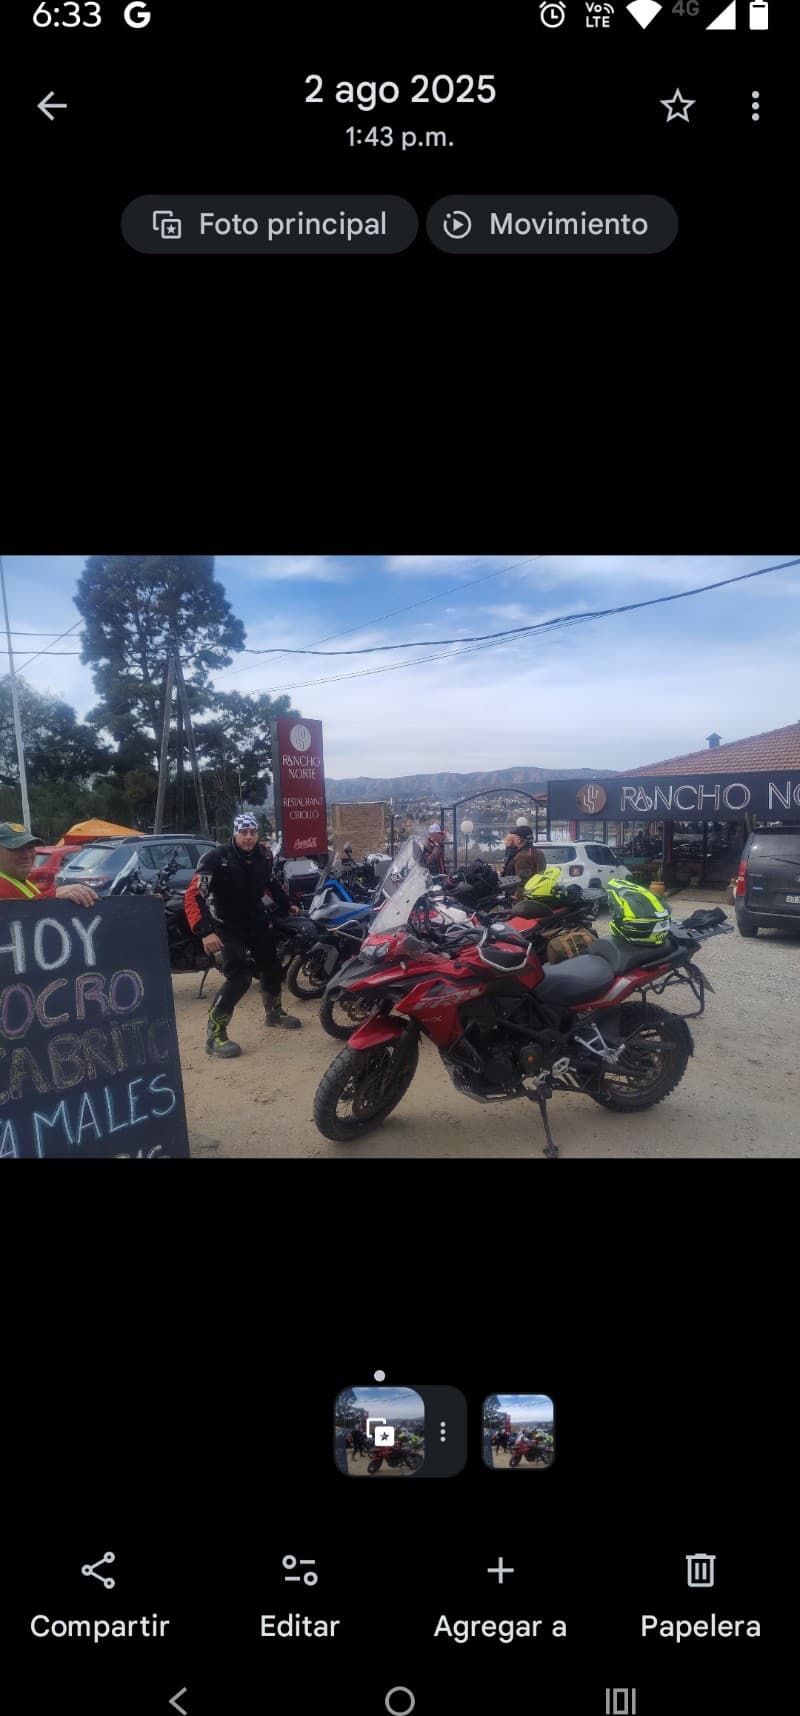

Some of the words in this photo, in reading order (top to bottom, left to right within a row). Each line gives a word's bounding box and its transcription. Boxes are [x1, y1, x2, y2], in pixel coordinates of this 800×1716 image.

[282, 755, 321, 767] RANCHO
[288, 768, 317, 779] NORTE
[283, 797, 323, 808] RESTAURANT
[620, 783, 751, 812] RANCHO
[768, 781, 800, 810] N
[0, 914, 102, 974] HOY
[0, 1073, 176, 1158] AMALES
